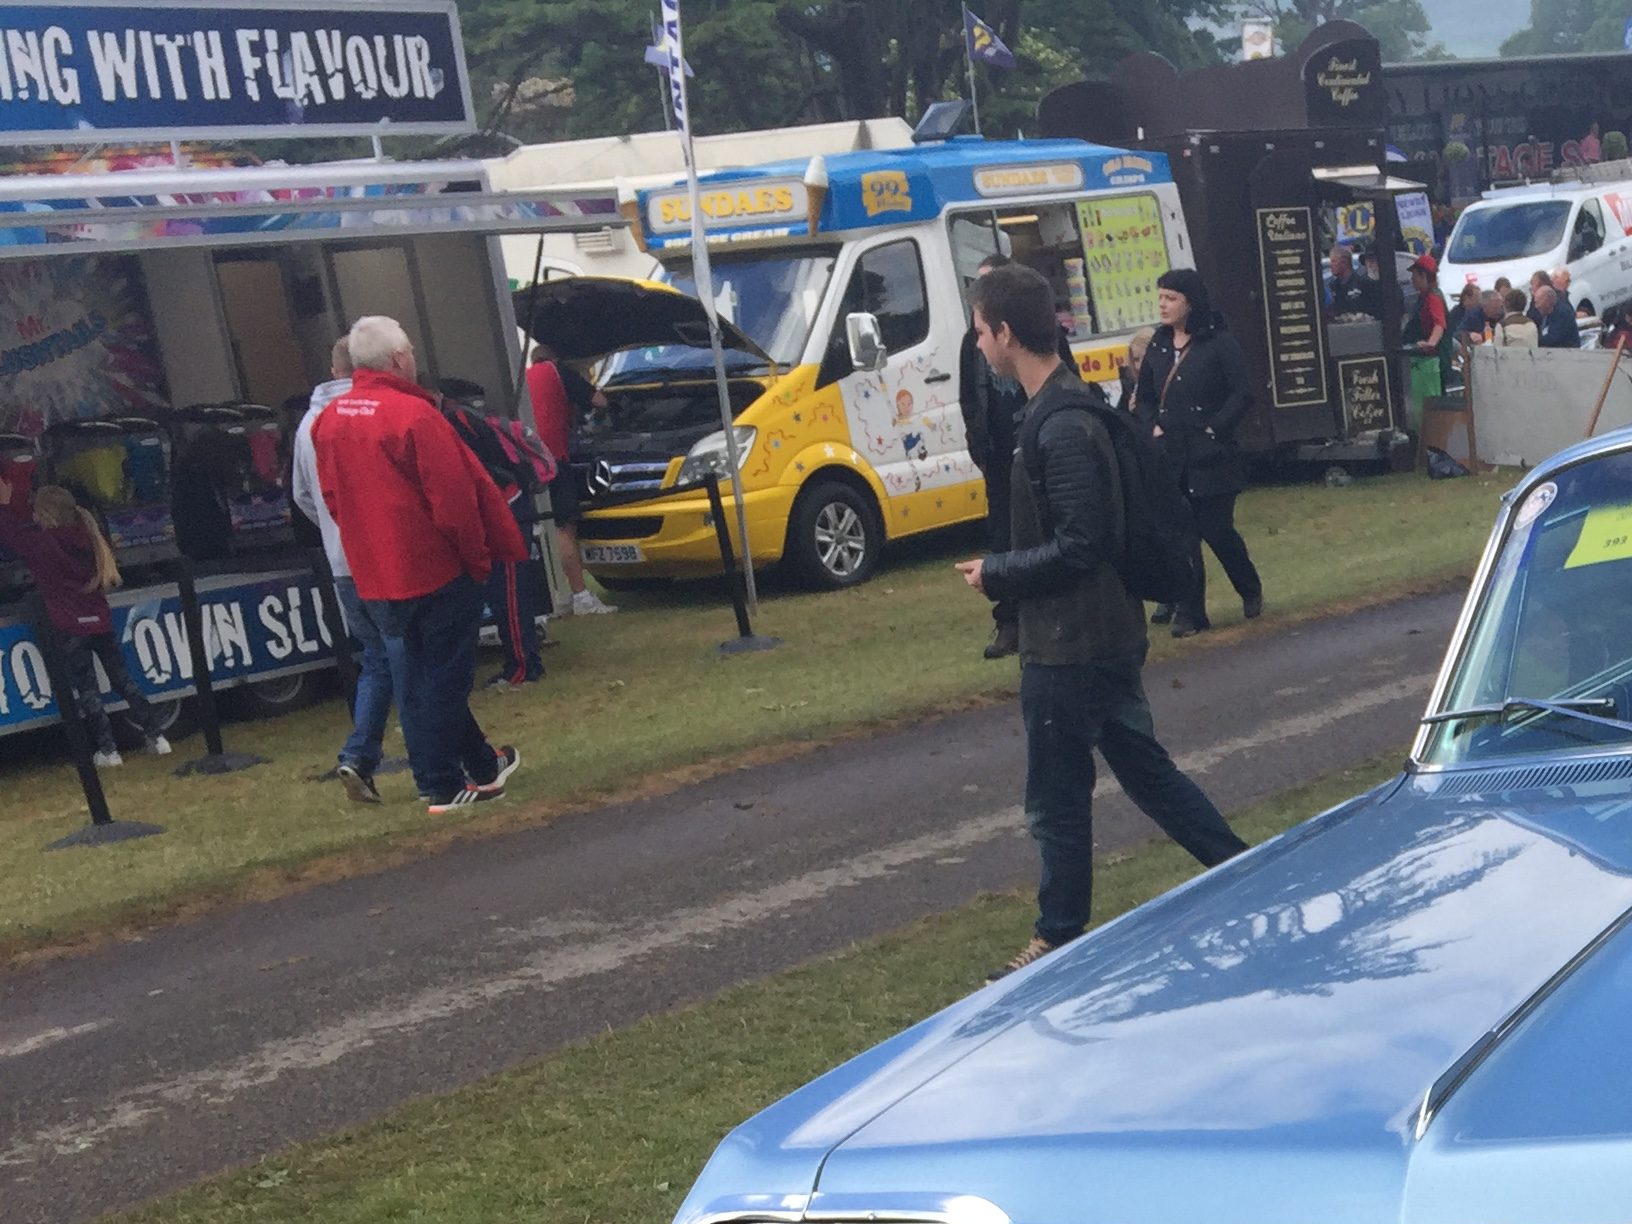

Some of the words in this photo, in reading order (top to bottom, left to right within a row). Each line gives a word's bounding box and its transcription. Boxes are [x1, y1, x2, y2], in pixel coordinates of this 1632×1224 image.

[87, 29, 231, 101] WITH
[235, 28, 438, 108] FLAVOUR
[660, 185, 794, 224] SUNDAES
